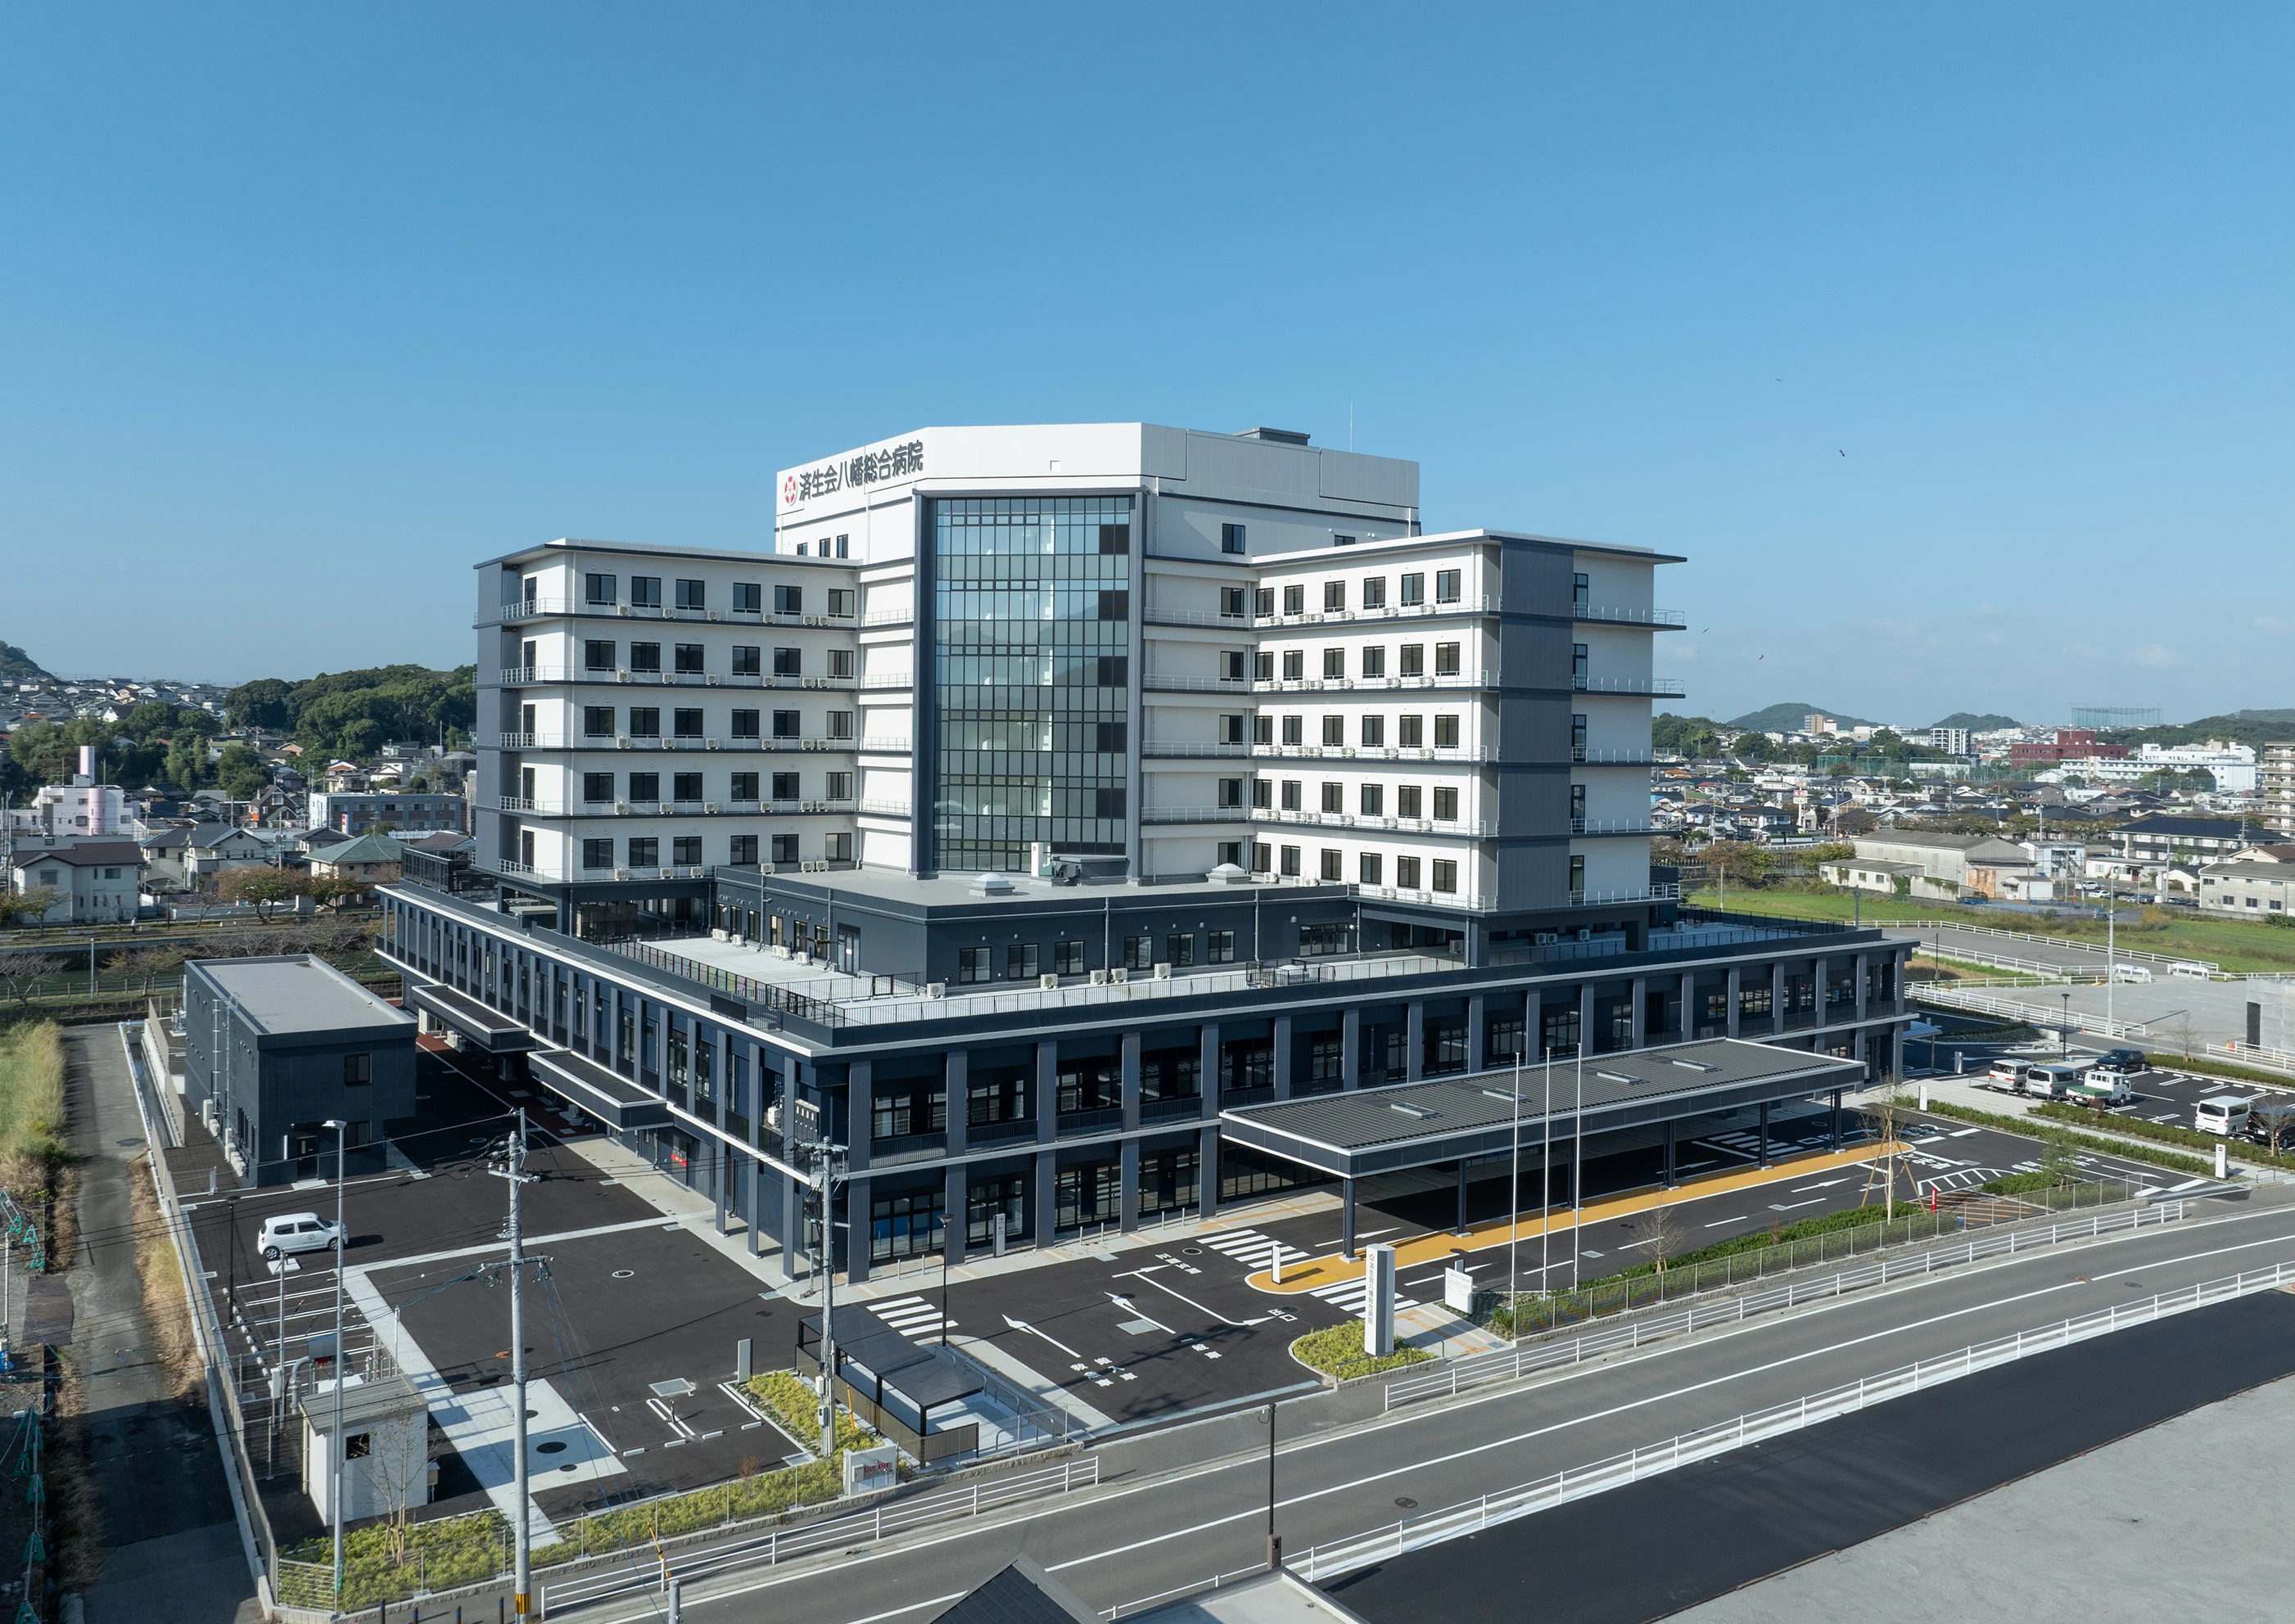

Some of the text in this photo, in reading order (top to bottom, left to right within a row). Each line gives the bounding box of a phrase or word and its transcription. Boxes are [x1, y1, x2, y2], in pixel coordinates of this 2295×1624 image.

[799, 440, 924, 501] 済生会八幡総合病院
[1154, 1252, 1202, 1274] 正面玄関
[1267, 1308, 1298, 1322] 出口
